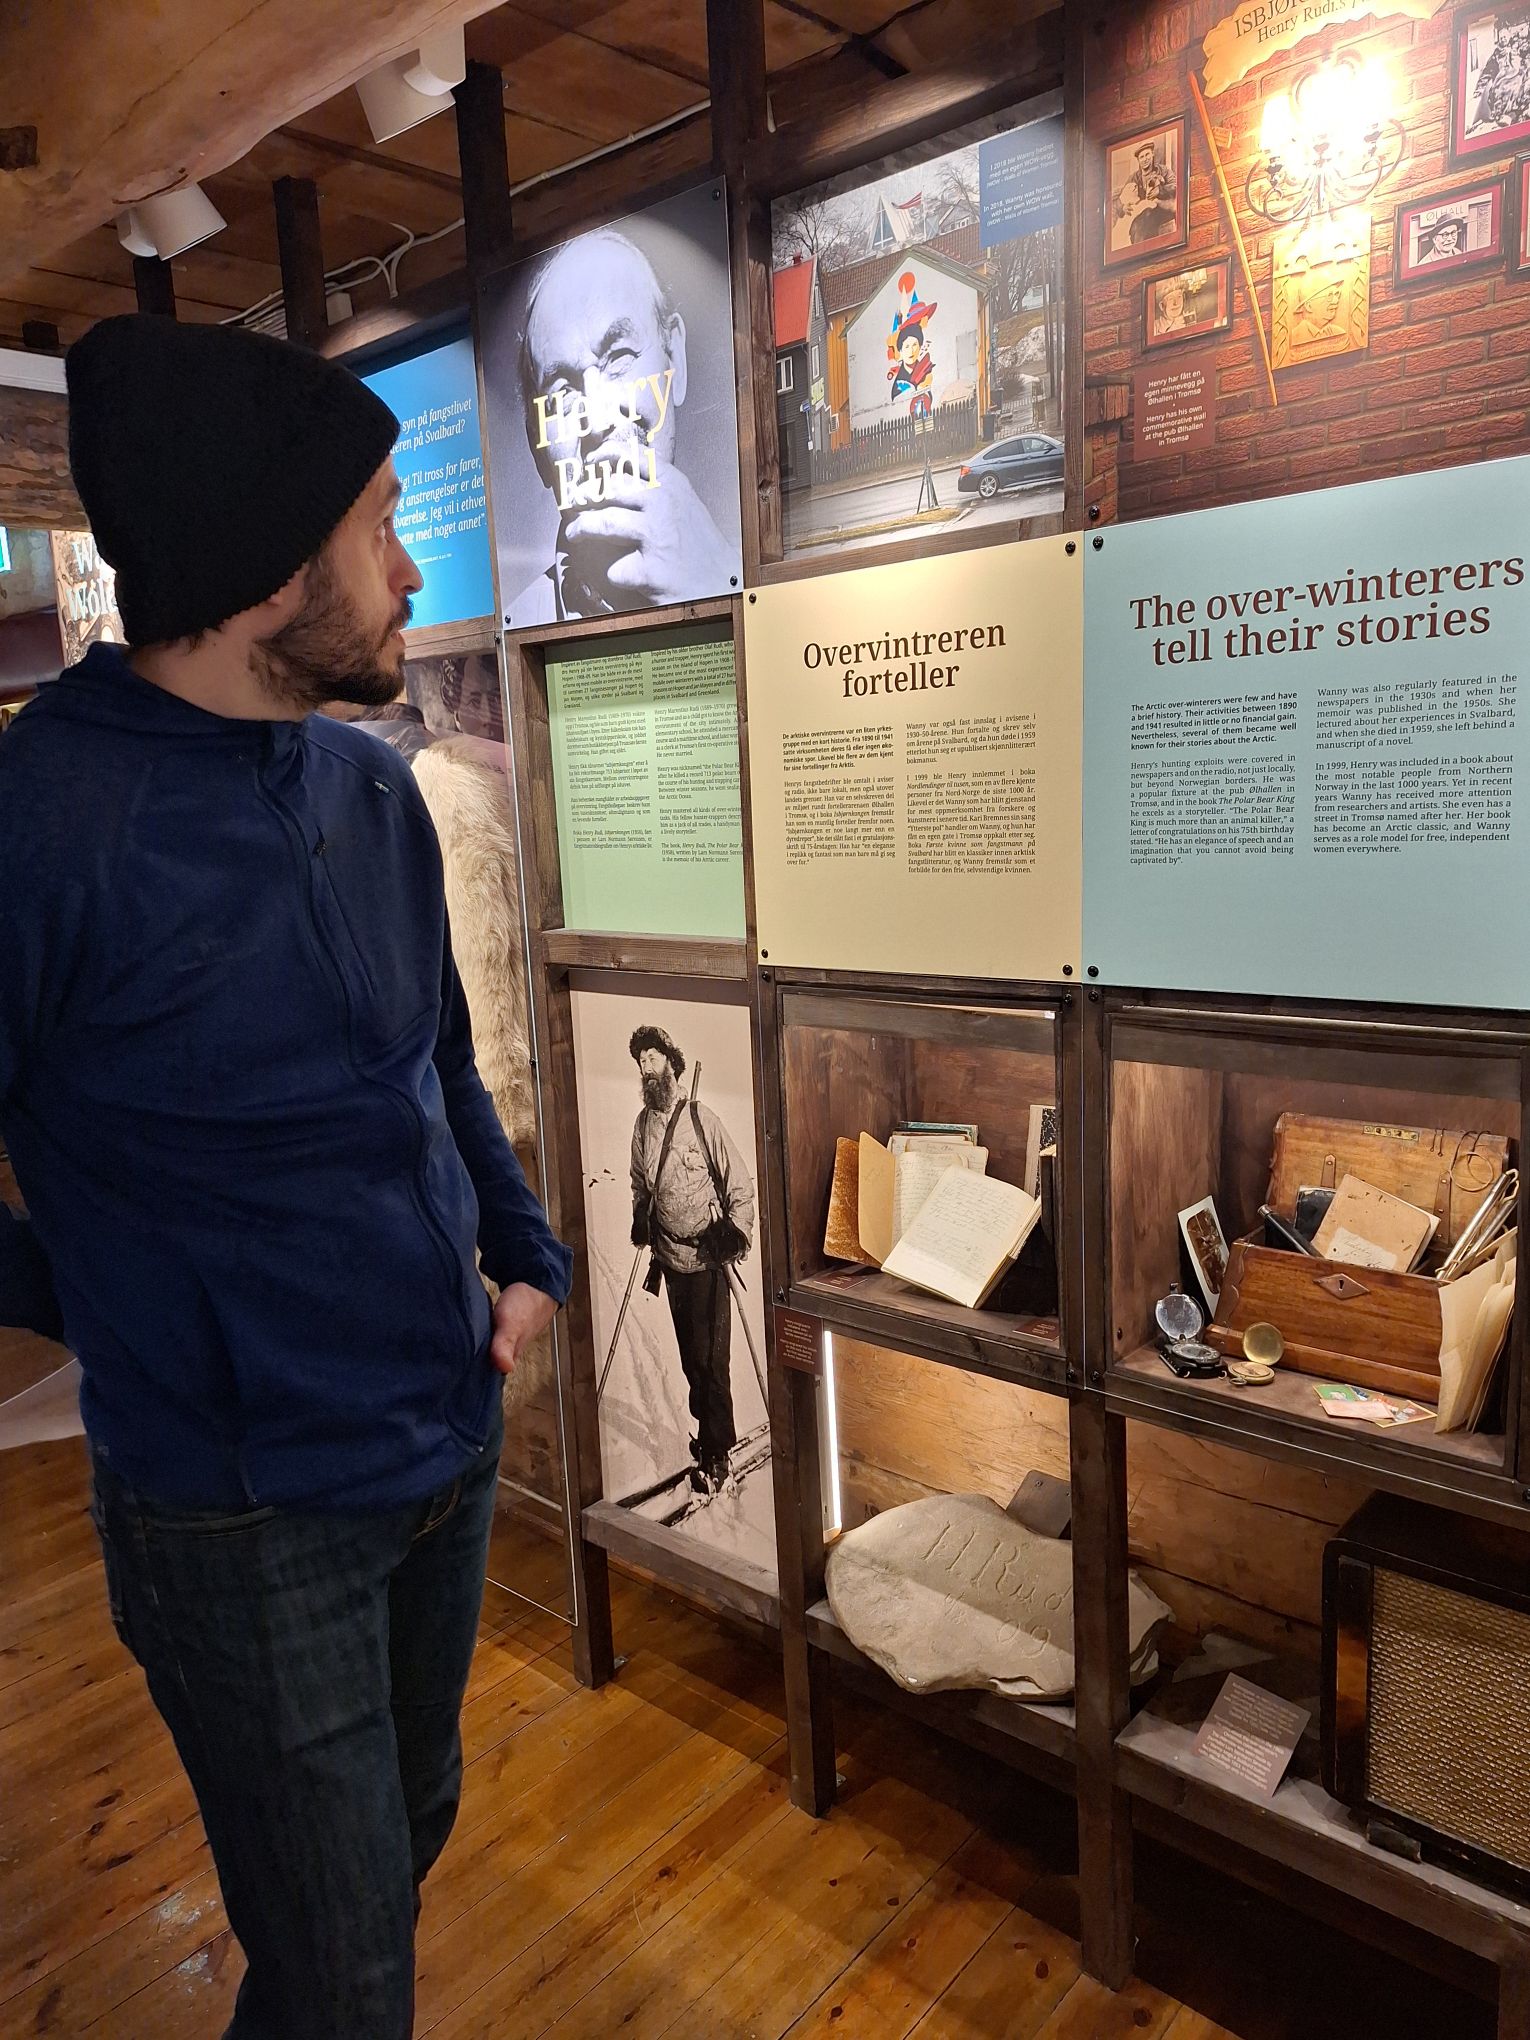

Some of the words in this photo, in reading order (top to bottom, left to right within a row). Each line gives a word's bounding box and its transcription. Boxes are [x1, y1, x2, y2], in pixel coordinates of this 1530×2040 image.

[1234, 0, 1306, 38] ISBJØ
[1257, 15, 1298, 43] Henry
[1144, 389, 1159, 398] egen
[1161, 381, 1195, 393] minnevegg
[1196, 376, 1204, 386] på
[1148, 379, 1167, 387] Henry
[1148, 395, 1173, 405] Ølhallen
[1178, 388, 1201, 398] Tromsø
[402, 418, 416, 434] syn
[418, 410, 428, 430] på
[429, 398, 471, 427] fangstlivet
[533, 368, 675, 449] Hery
[1146, 414, 1165, 422] Henry
[1142, 416, 1192, 432] commemorative
[1193, 412, 1206, 421] wall
[1164, 428, 1176, 437] pub
[1177, 423, 1203, 433] Ølhallen
[414, 431, 423, 451] på
[425, 419, 466, 444] Svalbard?
[1166, 434, 1189, 444] Tromsø
[412, 471, 422, 486] Til
[425, 467, 444, 482] tross
[446, 462, 458, 480] for
[460, 457, 481, 476] farer,
[406, 483, 458, 507] anstrengelser
[460, 480, 469, 492] er
[472, 475, 484, 489] det
[430, 507, 442, 523] Jeg
[444, 500, 454, 516] vil
[416, 525, 432, 542] med
[434, 521, 456, 538] noget
[1129, 594, 1196, 630] The
[1206, 555, 1526, 620] over-winterers
[1152, 628, 1212, 666] tell
[1223, 617, 1325, 659] their
[1336, 601, 1491, 647] stories
[803, 623, 1006, 669] Overvintreren
[842, 661, 960, 698] forteller
[1137, 712, 1154, 720] brief
[1185, 709, 1204, 717] Their
[1206, 706, 1240, 715] activities
[1242, 704, 1276, 712] between
[1279, 701, 1297, 710] 1890
[1145, 702, 1166, 710] Arctic
[1168, 699, 1221, 708] over-winterers
[1260, 692, 1276, 701] and
[1202, 717, 1220, 726] little
[1242, 713, 1276, 723] financial
[1276, 712, 1296, 722] gain.
[1168, 740, 1185, 748] their
[1187, 738, 1212, 746] stories
[1252, 734, 1276, 742] Arctic.
[1182, 728, 1208, 737] several
[1211, 727, 1219, 735] of
[1332, 824, 1366, 832] become
[1385, 823, 1412, 831] Arctic
[1416, 822, 1449, 831] classic,
[1453, 821, 1471, 830] and
[1476, 821, 1510, 831] Wanny
[1346, 845, 1401, 854] everywhere.
